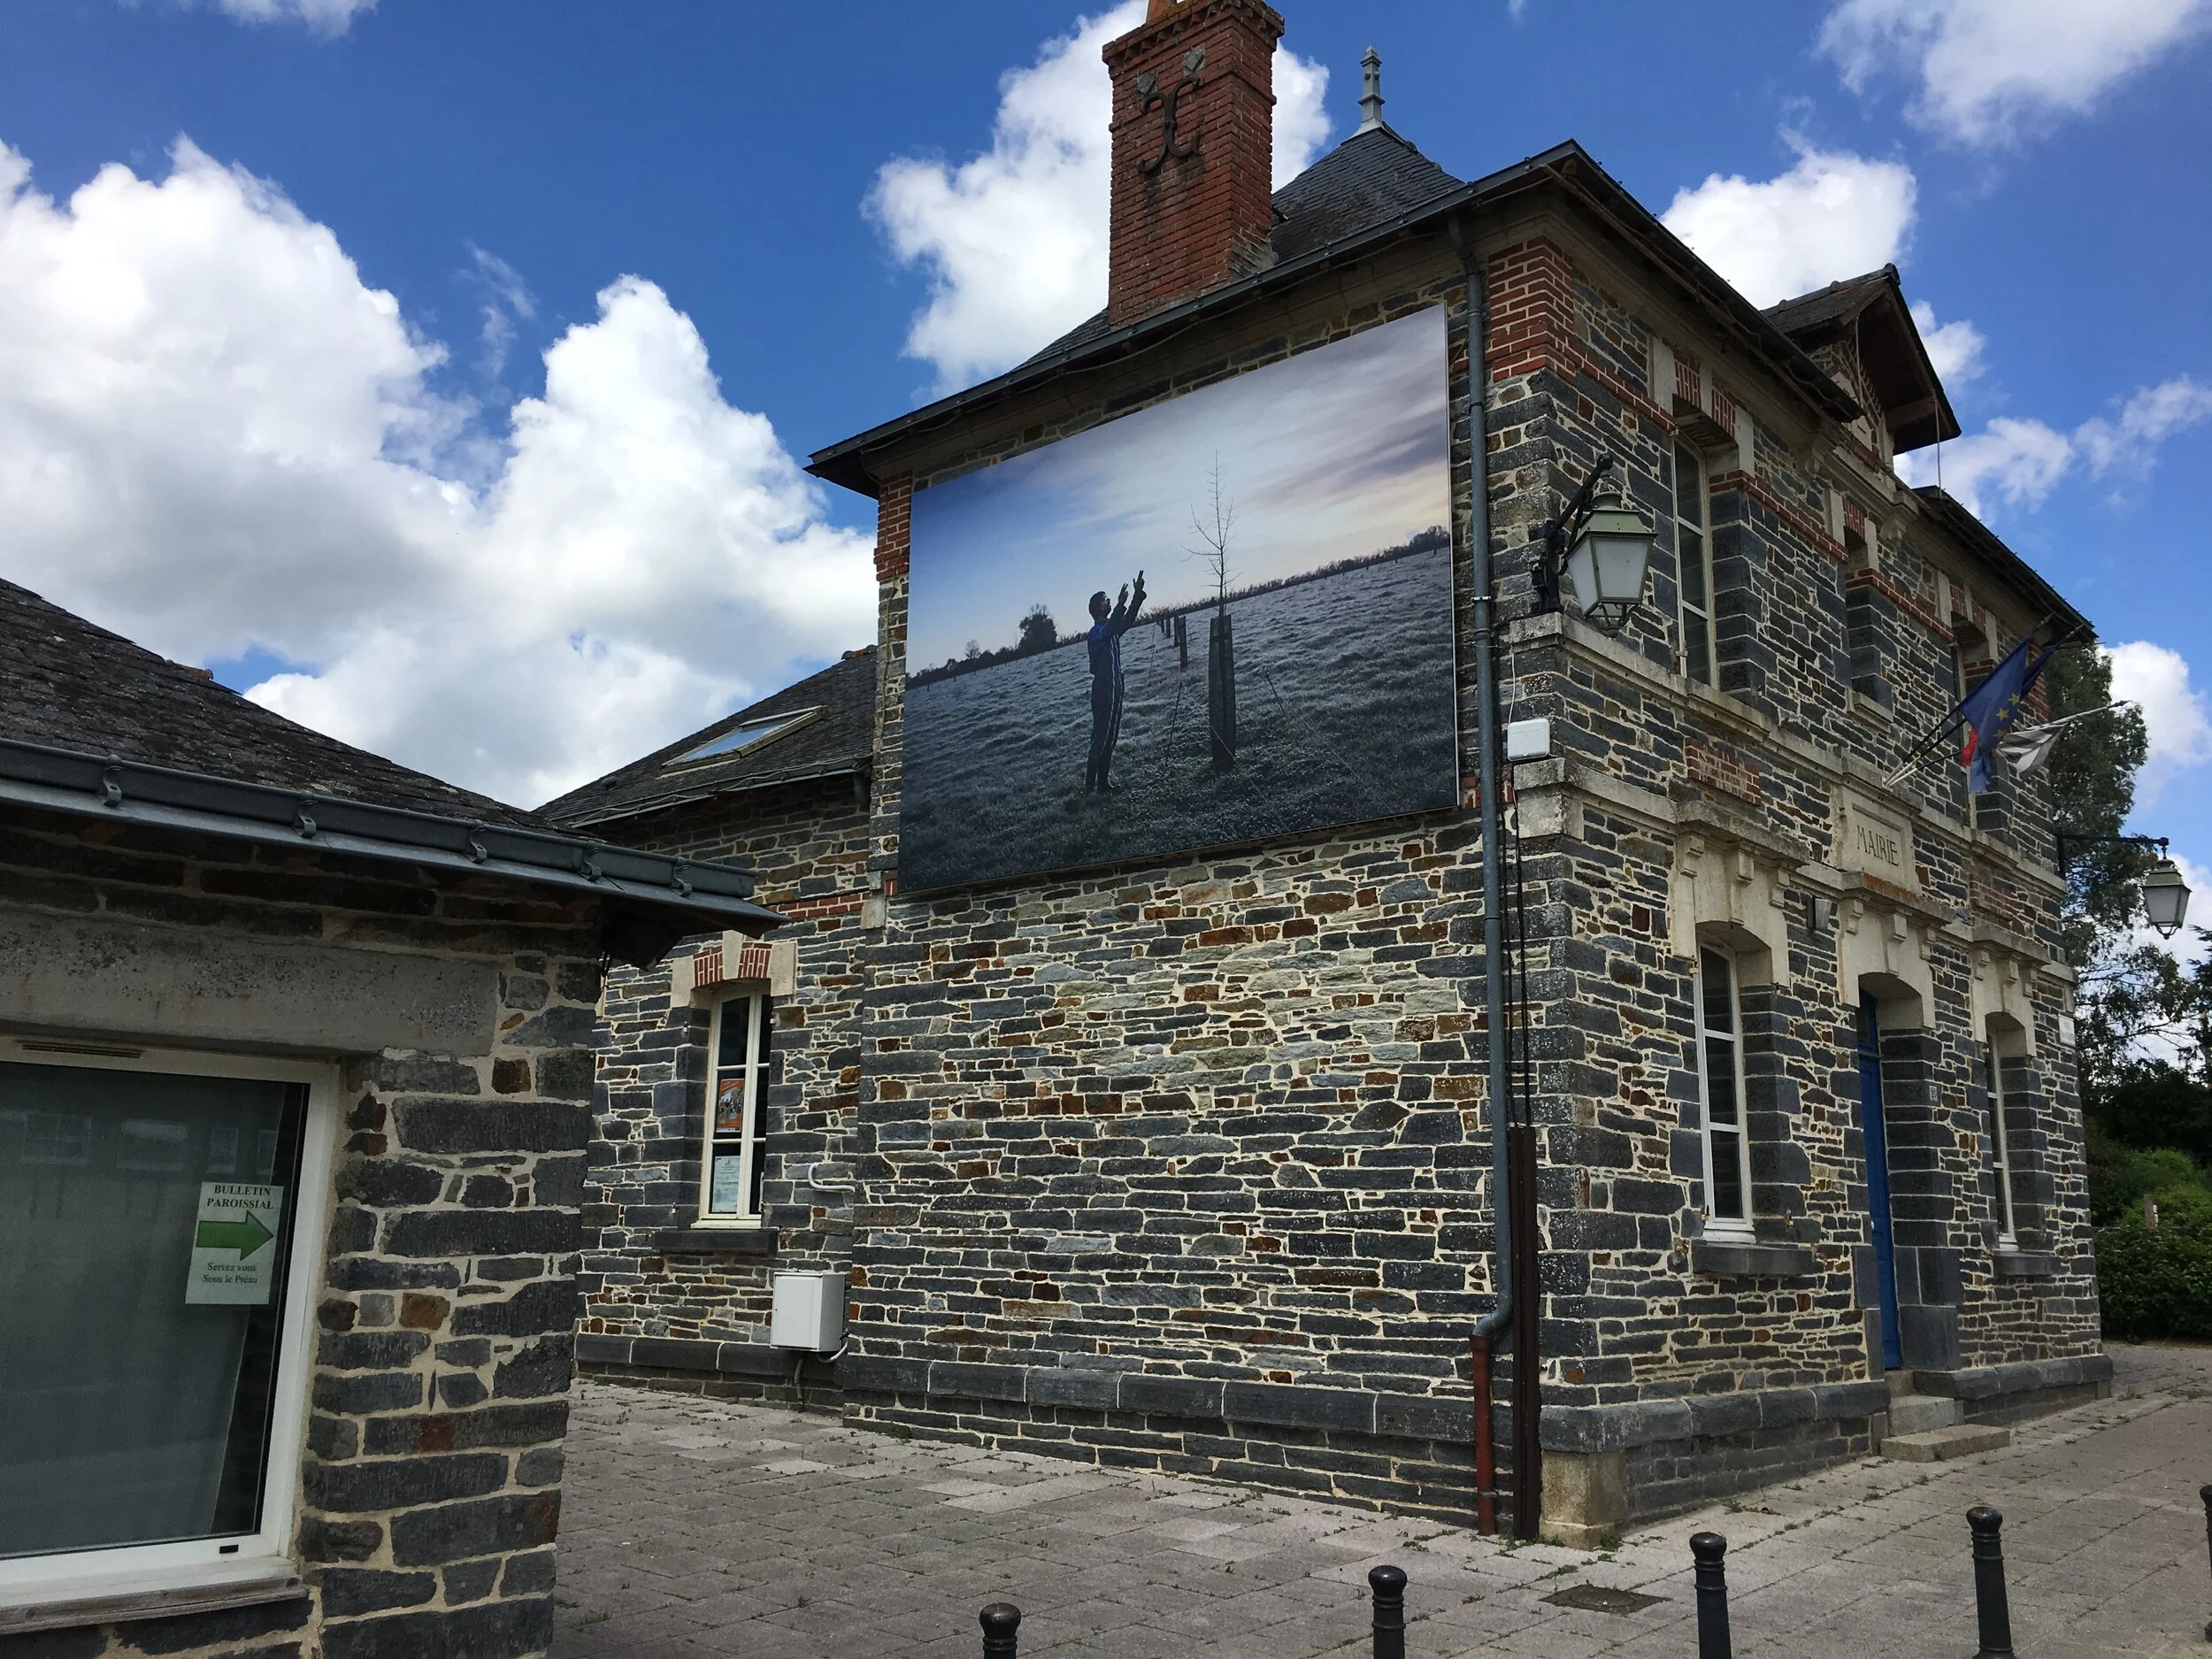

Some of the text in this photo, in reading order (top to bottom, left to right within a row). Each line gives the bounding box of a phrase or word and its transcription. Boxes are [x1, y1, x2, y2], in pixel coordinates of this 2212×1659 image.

[1856, 825, 1899, 867] MAIRIE
[214, 1185, 271, 1195] BULLETIN
[207, 1197, 273, 1210] PAROISSIAL
[207, 1263, 234, 1271] Servez
[203, 1274, 257, 1283] Sous le Préau
